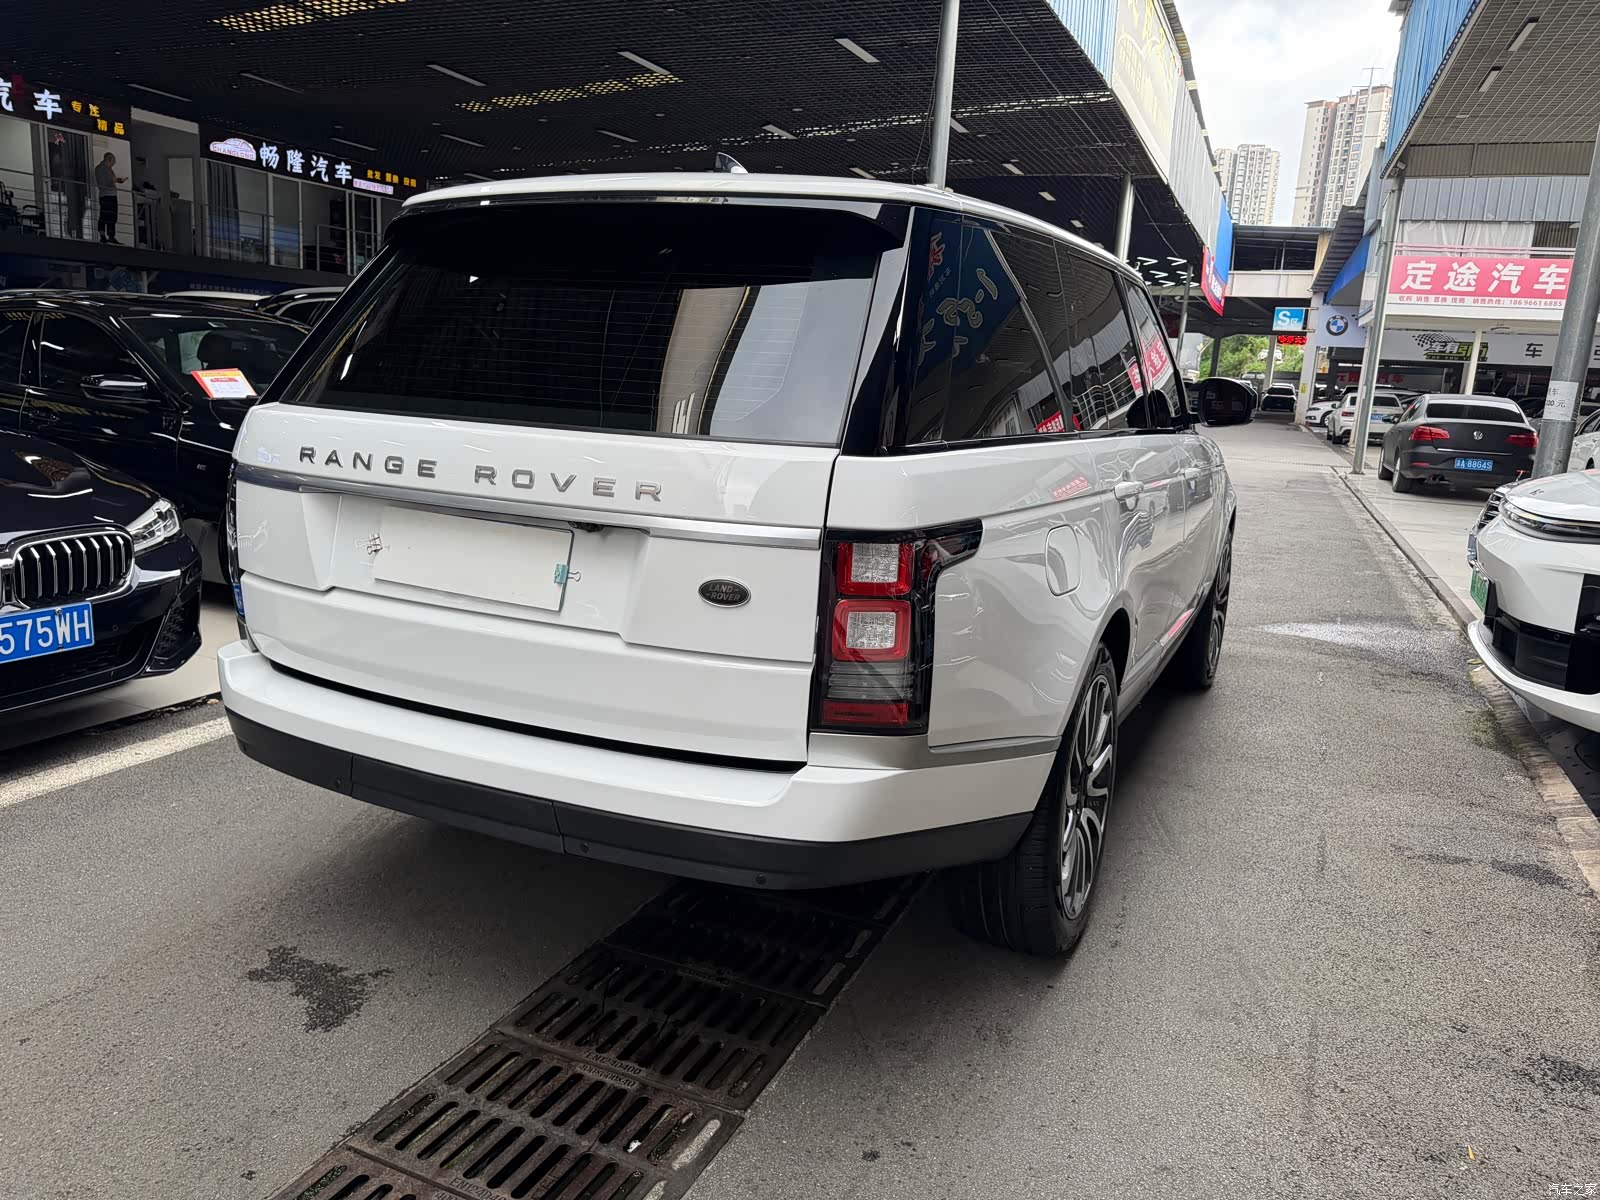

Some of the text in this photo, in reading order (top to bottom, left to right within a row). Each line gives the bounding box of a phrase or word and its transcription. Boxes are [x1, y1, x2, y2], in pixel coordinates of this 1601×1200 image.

[71, 100, 100, 117] 专注
[97, 118, 125, 135] 精品
[212, 145, 255, 160] CHANGLONG
[259, 142, 352, 185] 畅隆汽车
[1400, 260, 1570, 295] 定途汽车
[299, 445, 663, 502] RANGE ROVER
[708, 584, 733, 593] LAND
[710, 592, 741, 601] ROVER
[0, 609, 91, 655] 575WH
